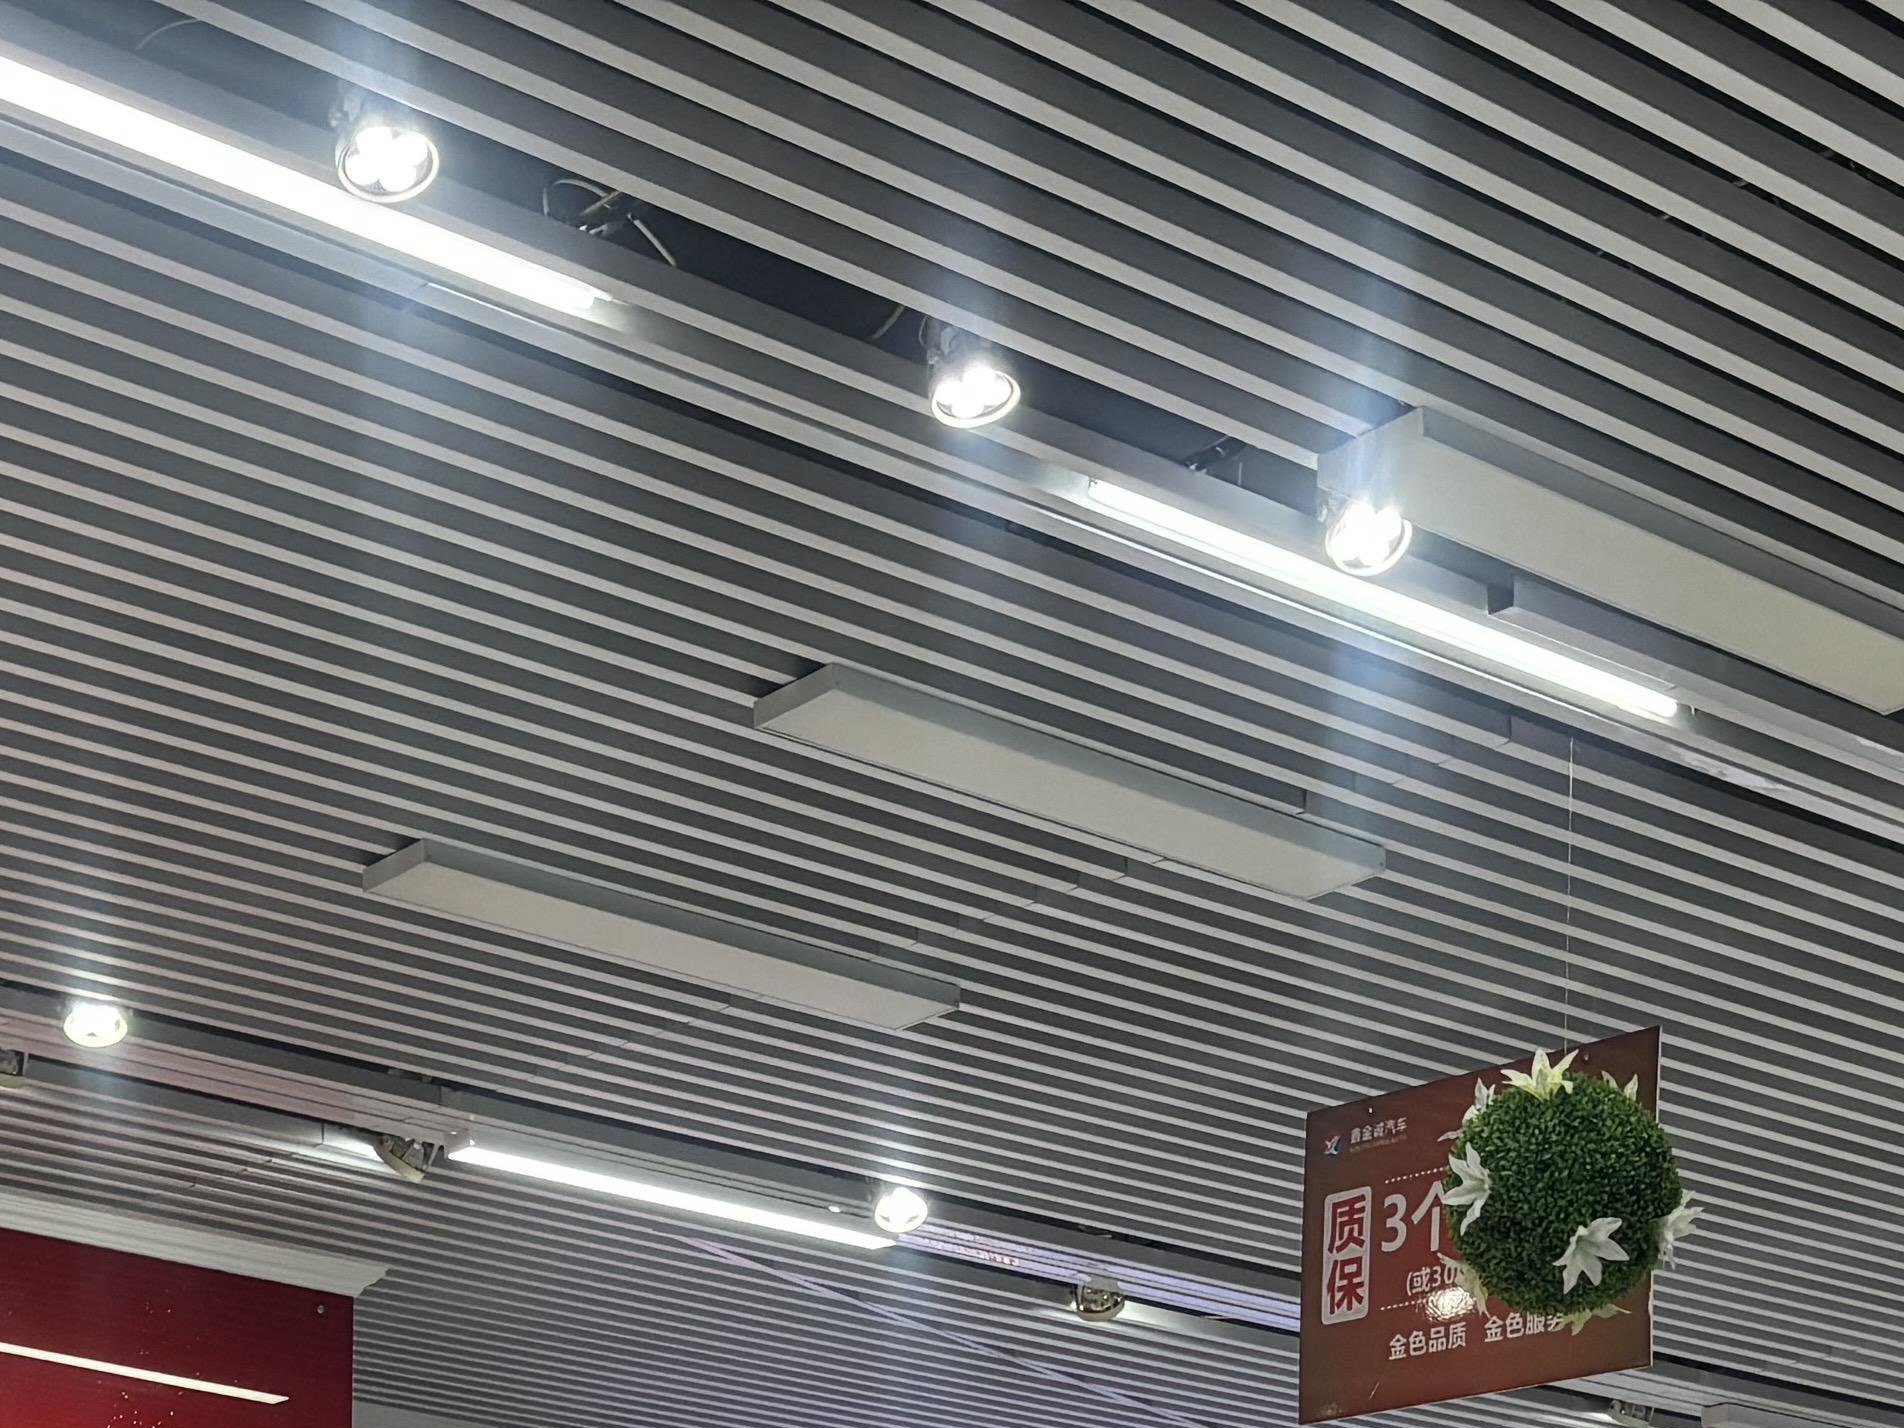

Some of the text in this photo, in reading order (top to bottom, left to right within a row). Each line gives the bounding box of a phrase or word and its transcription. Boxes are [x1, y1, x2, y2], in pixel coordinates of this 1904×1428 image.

[1326, 1193, 1366, 1314] 质保
[1388, 1321, 1467, 1361] 金色品质
